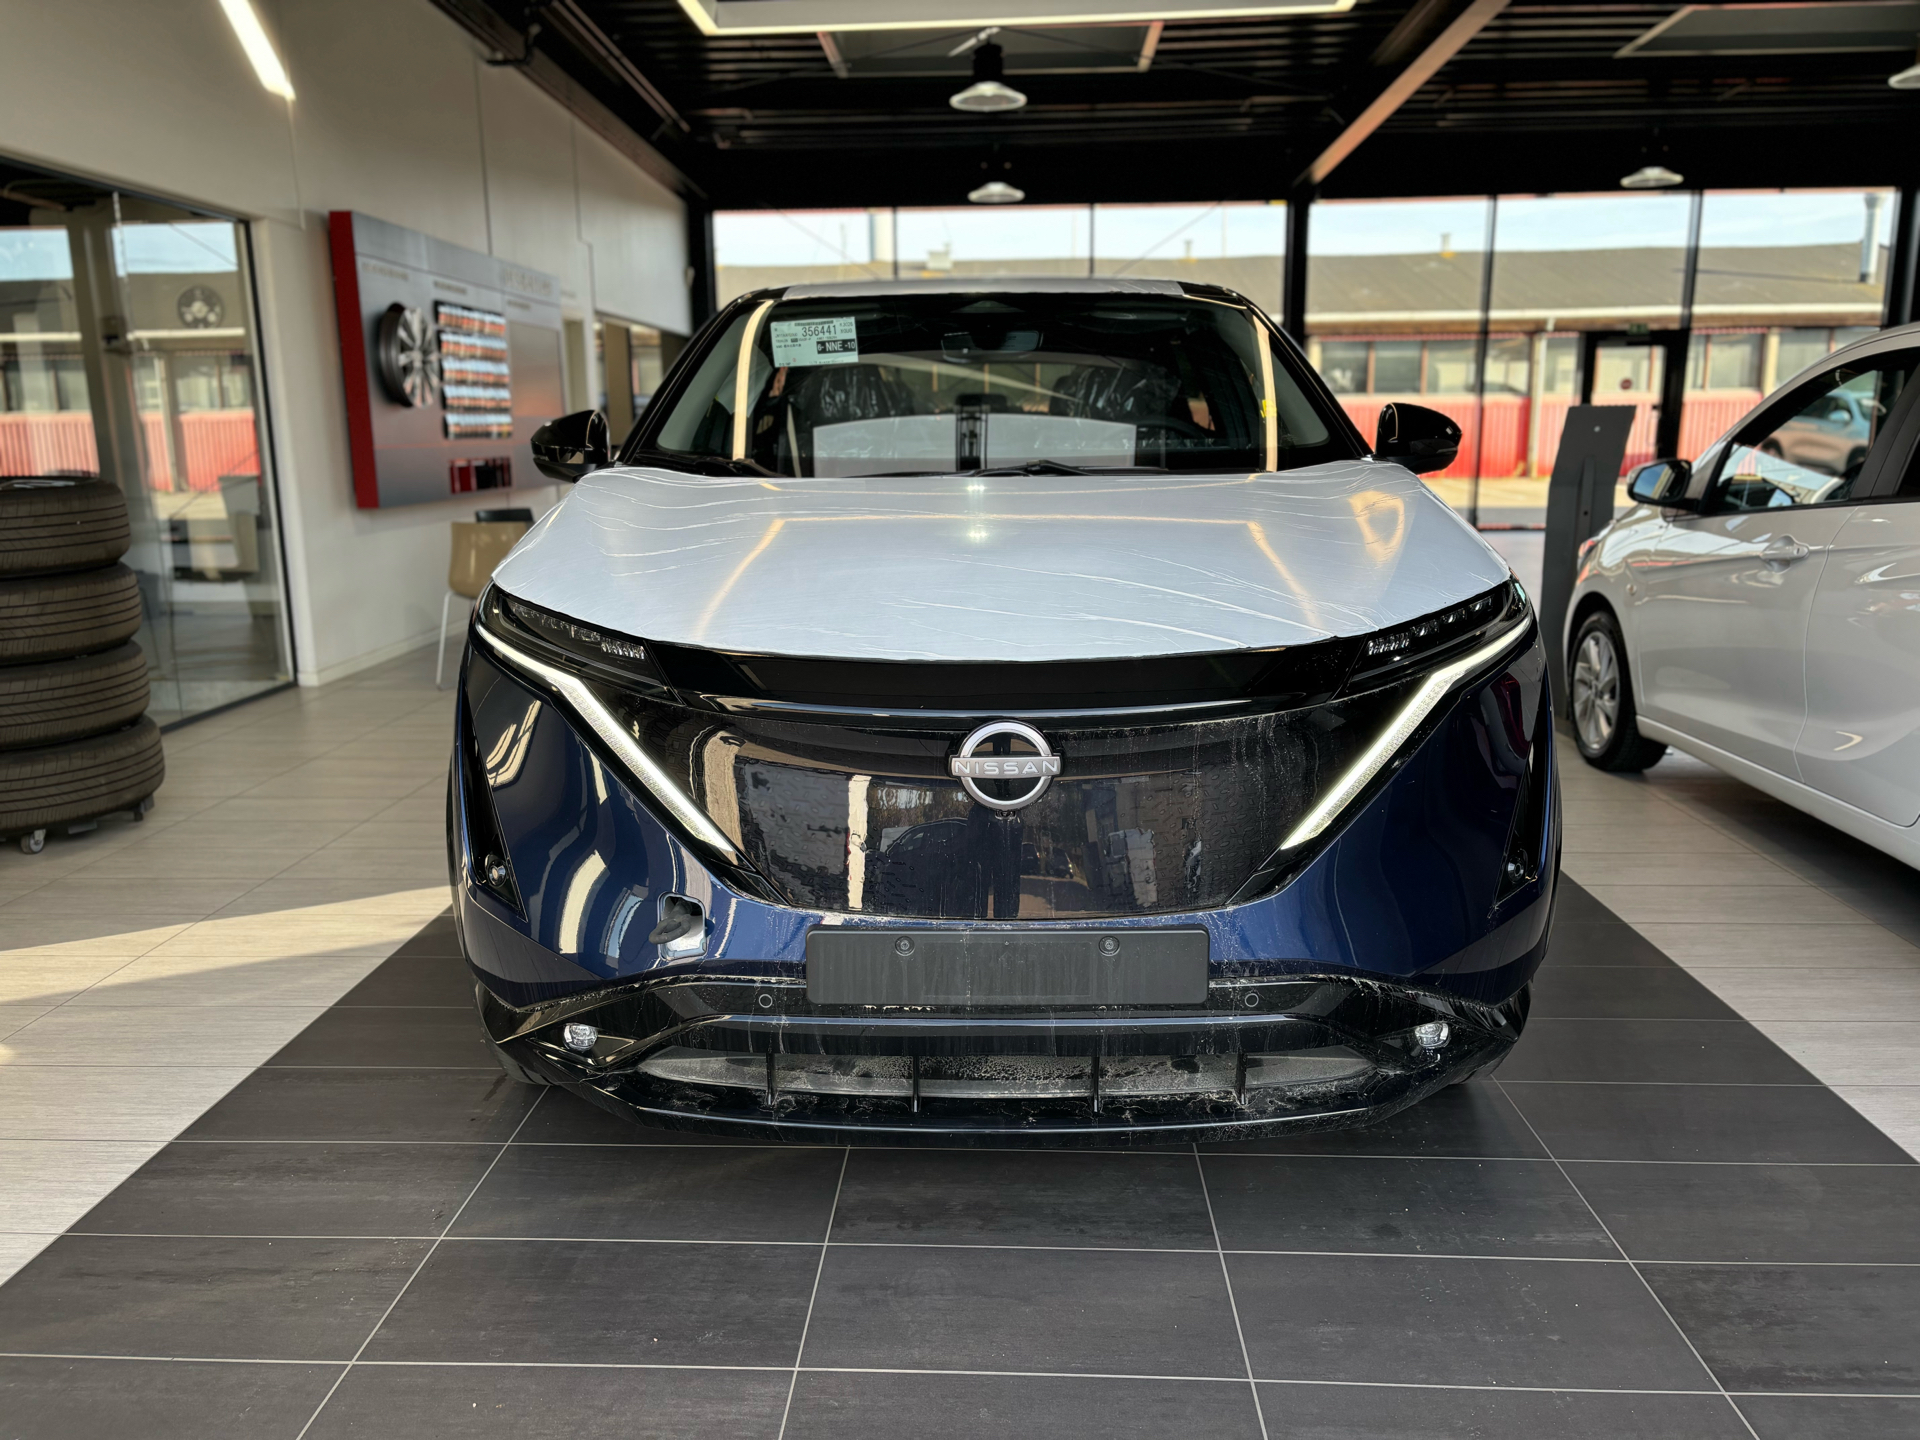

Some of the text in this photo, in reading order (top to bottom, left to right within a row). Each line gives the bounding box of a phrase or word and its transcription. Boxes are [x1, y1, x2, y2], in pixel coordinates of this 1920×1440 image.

[801, 325, 837, 337] 356441
[825, 341, 843, 352] NNE
[954, 760, 1058, 775] NISSAN
